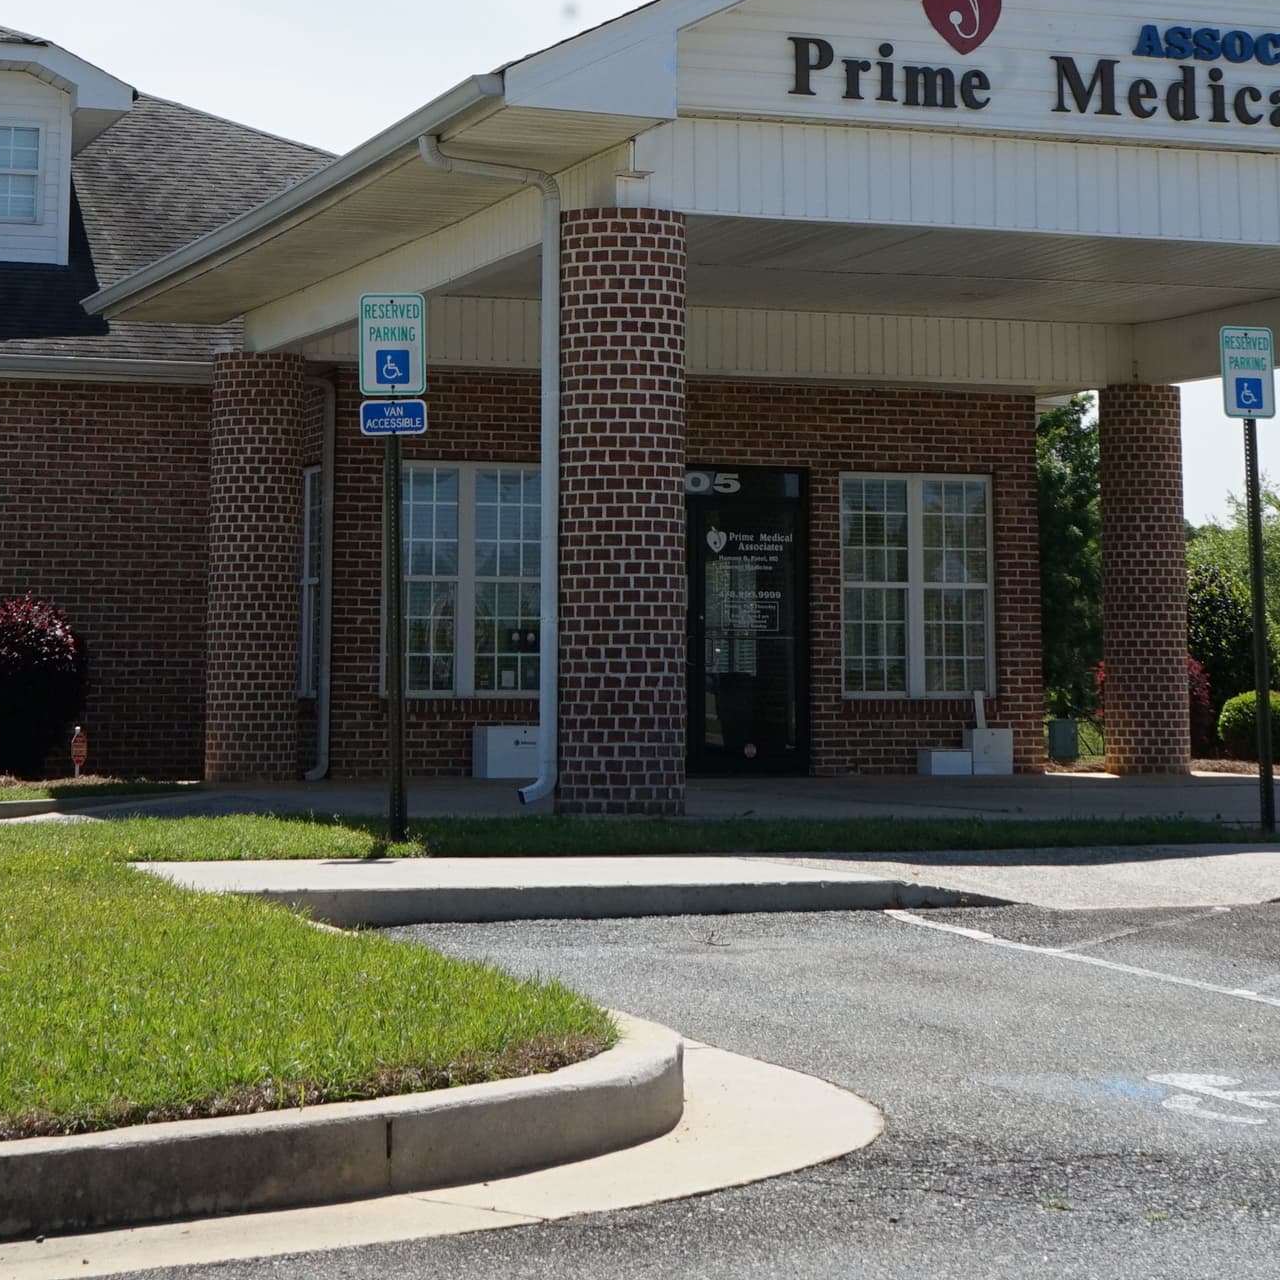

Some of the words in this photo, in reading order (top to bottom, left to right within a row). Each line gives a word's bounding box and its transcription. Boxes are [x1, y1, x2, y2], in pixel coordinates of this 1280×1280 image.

[787, 36, 992, 111] Prime
[364, 303, 420, 320] RESERVED
[369, 326, 416, 342] PARKING
[1224, 335, 1269, 351] RESERVED
[1228, 355, 1267, 371] PARKING
[383, 406, 404, 417] VAN
[365, 417, 422, 429] ACCESSIBLE
[729, 531, 754, 542] Prime
[759, 532, 793, 543] Medical
[738, 542, 784, 552] Associates
